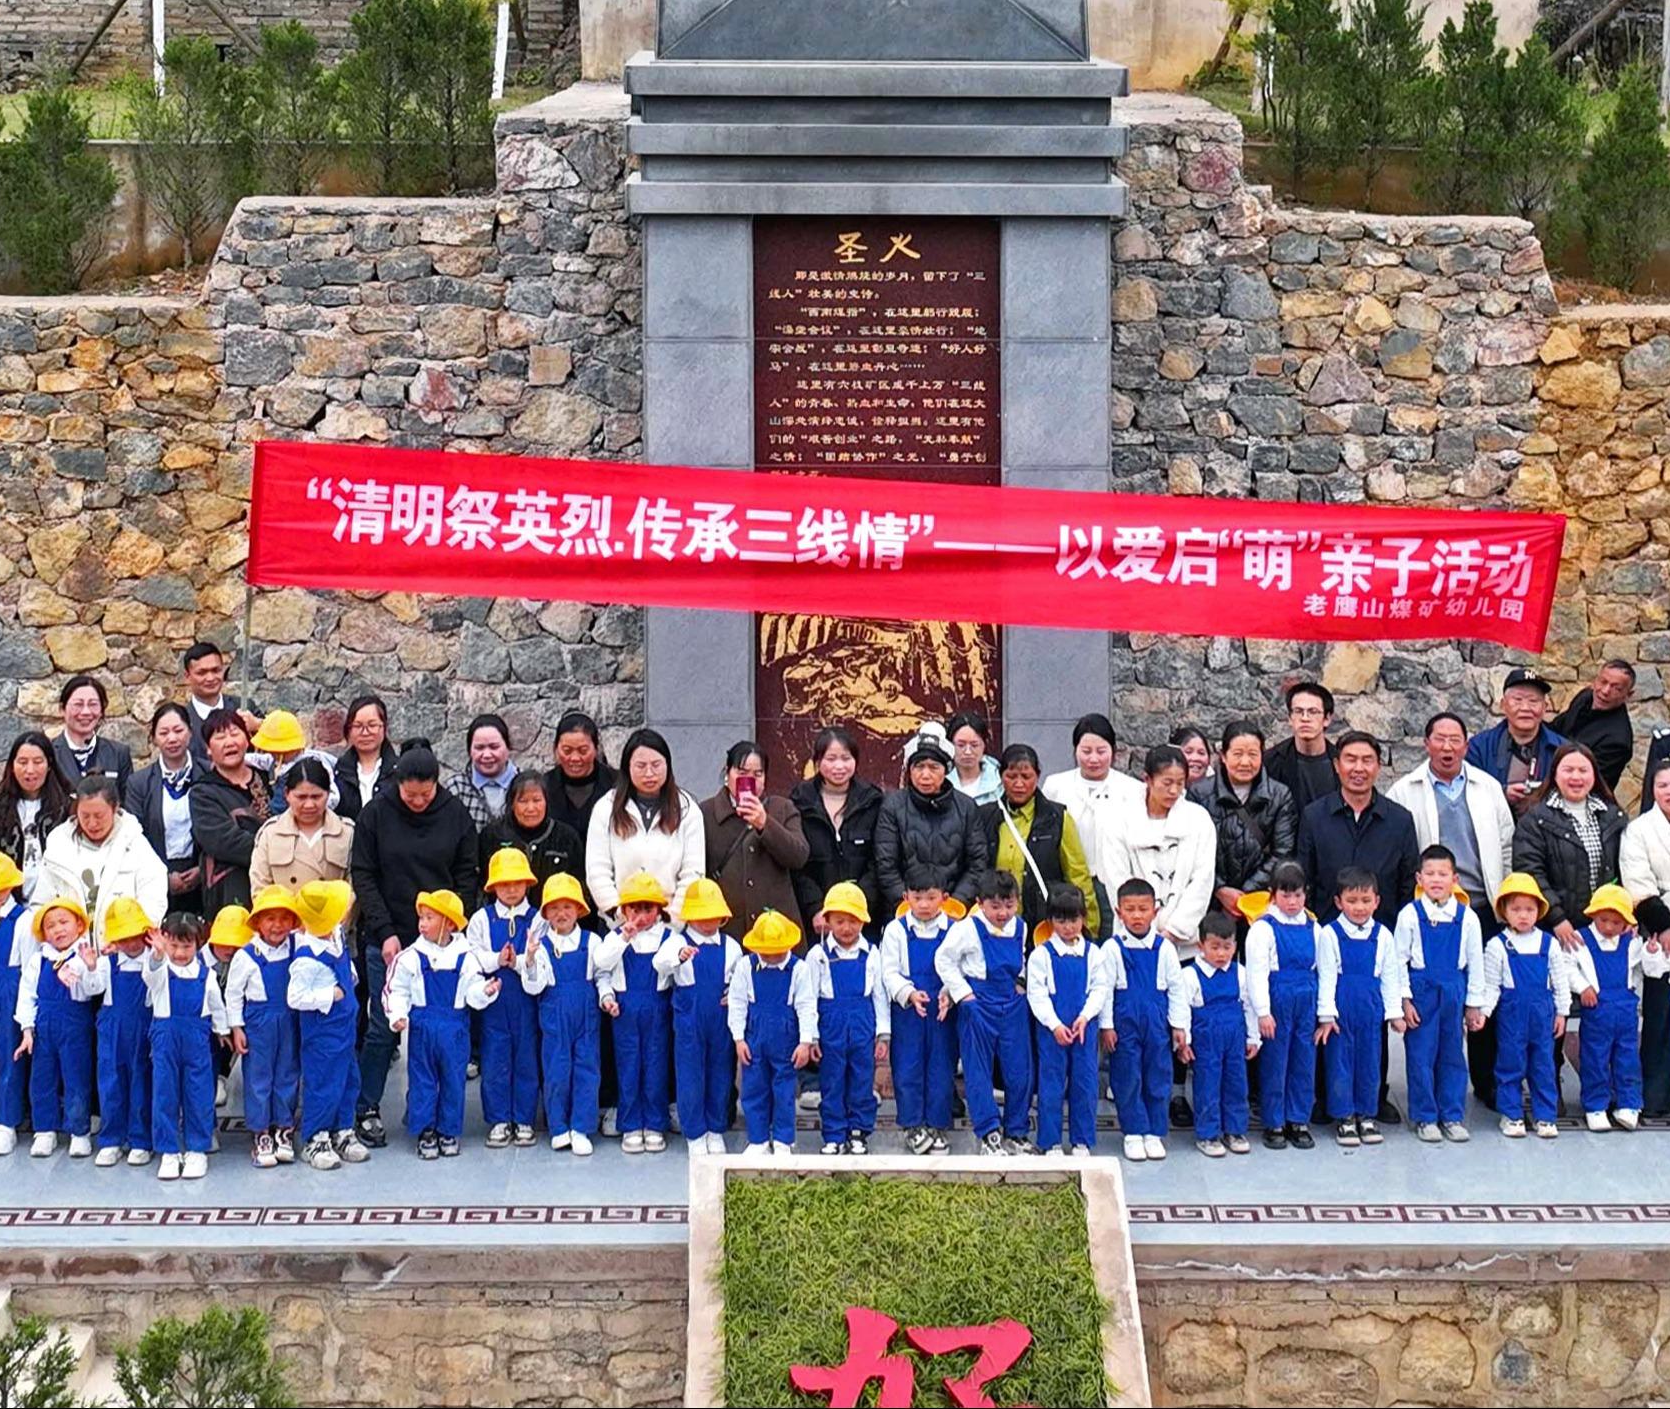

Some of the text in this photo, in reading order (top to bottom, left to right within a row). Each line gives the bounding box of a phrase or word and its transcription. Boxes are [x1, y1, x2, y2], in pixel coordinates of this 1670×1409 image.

[833, 231, 921, 264] 圣火
[1303, 593, 1524, 622] 老鹰山煤矿幼儿园
